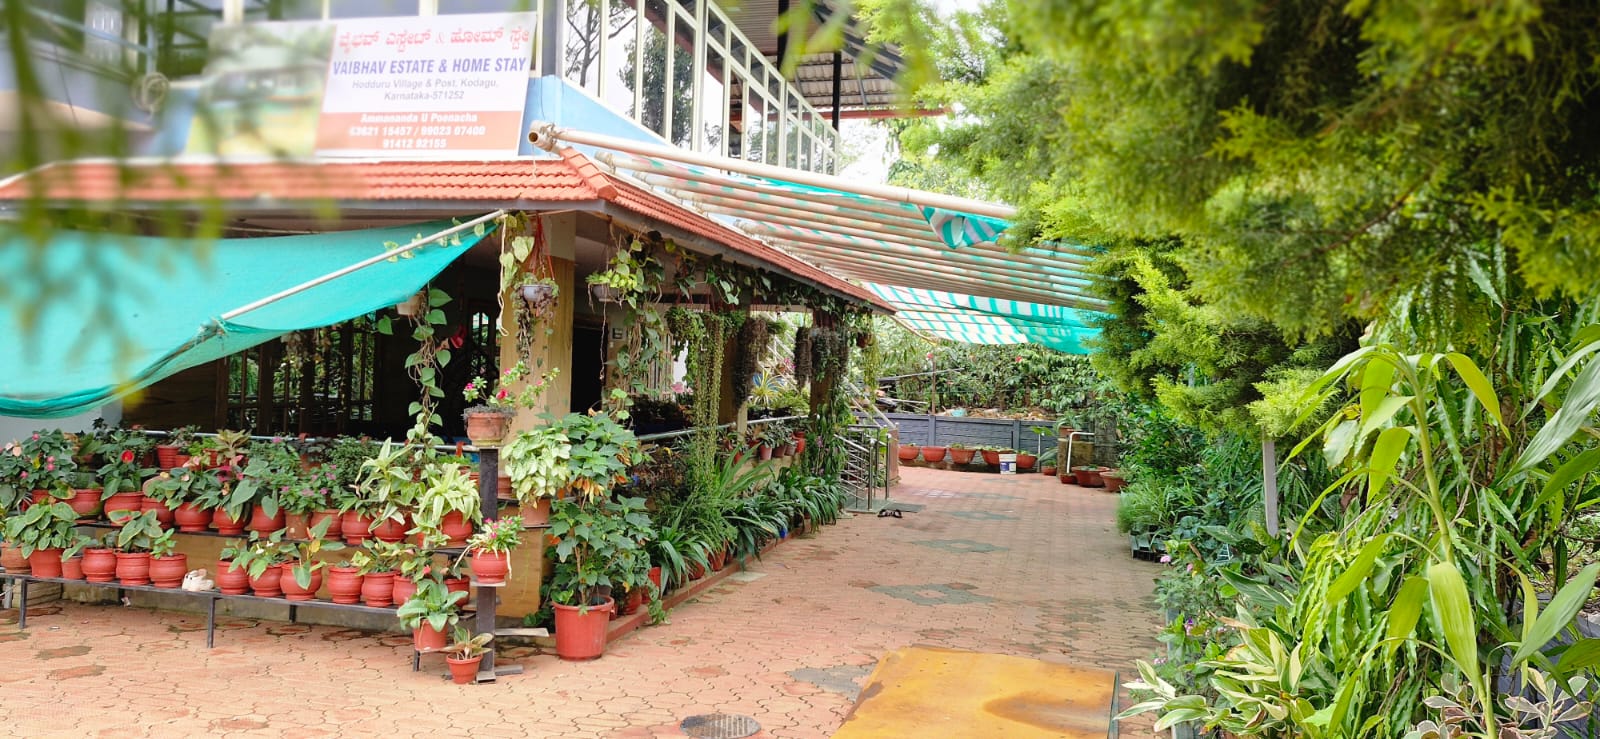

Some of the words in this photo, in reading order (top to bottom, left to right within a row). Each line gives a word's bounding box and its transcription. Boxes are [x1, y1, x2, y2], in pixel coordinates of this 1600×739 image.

[333, 60, 387, 75] VAIBHAV
[389, 59, 435, 74] ESTATE
[438, 58, 448, 73] &
[452, 57, 491, 73] HOME
[494, 56, 527, 72] STAY
[352, 80, 391, 89] Hodduru
[393, 79, 423, 90] Village
[425, 79, 432, 88] &
[383, 90, 465, 101] Karnataka-571252
[421, 112, 428, 123] U
